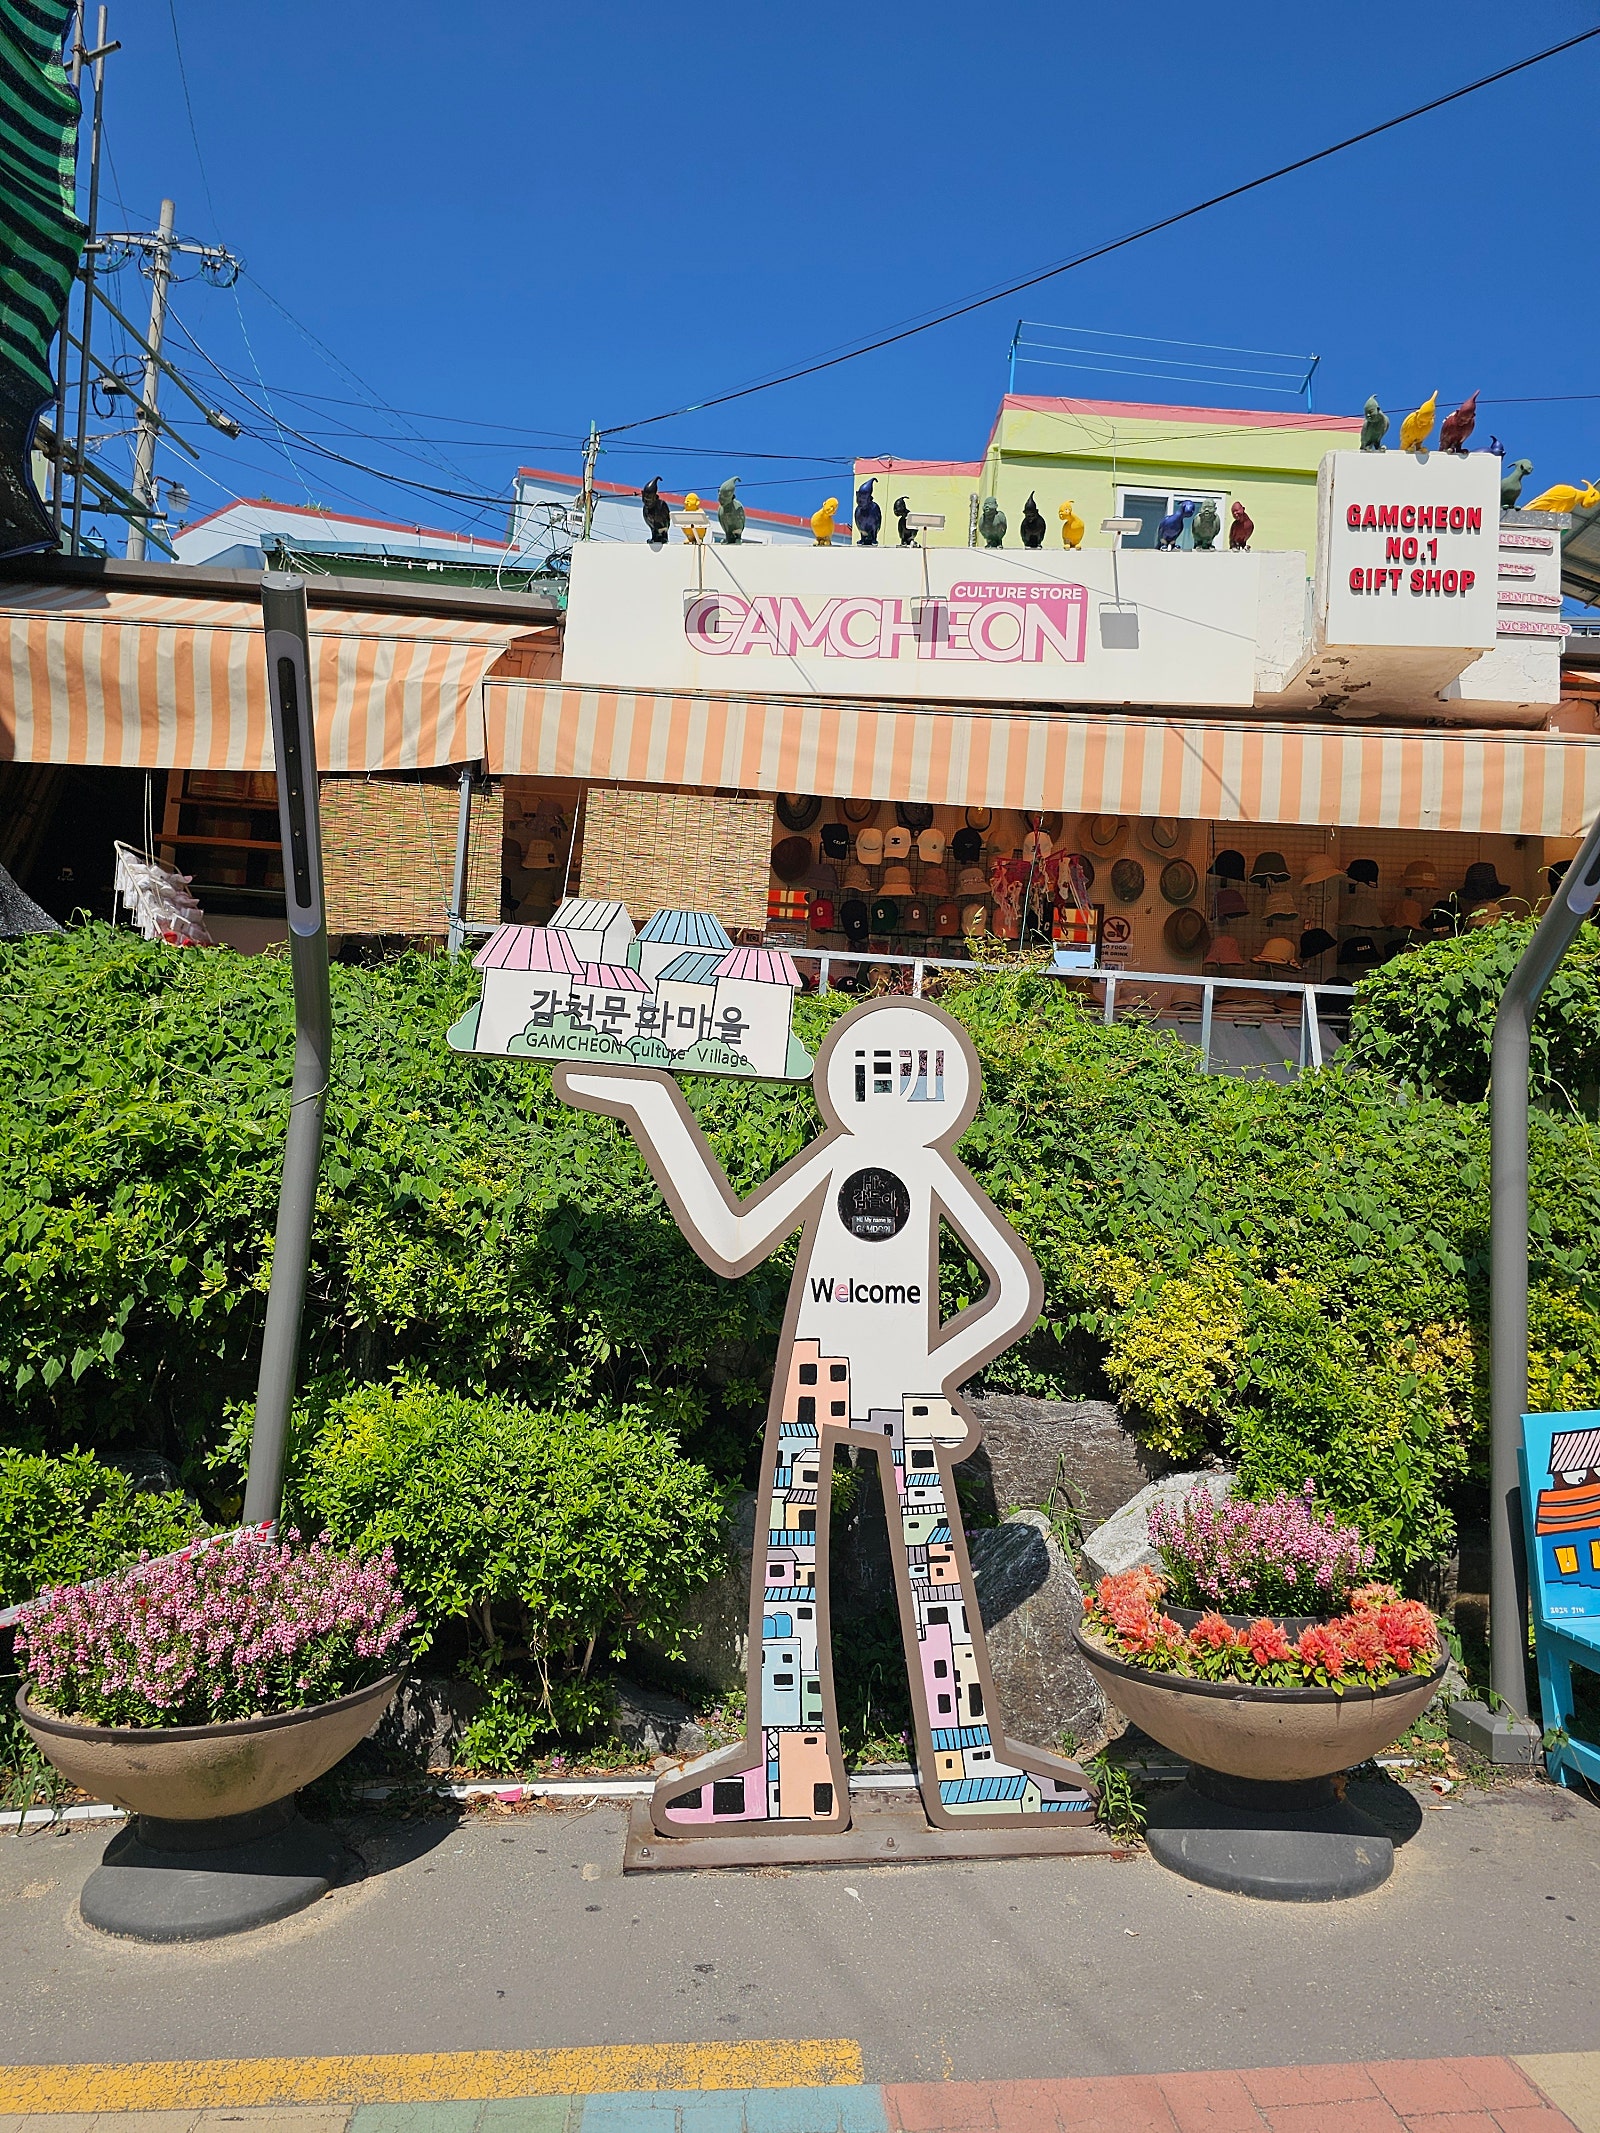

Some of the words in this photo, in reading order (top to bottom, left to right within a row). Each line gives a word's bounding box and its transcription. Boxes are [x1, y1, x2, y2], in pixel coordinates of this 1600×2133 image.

[1346, 504, 1482, 529] GAMCHEON
[1386, 536, 1438, 560] NO.1
[954, 585, 1027, 600] CULTURE
[1030, 587, 1082, 600] STORE
[1350, 567, 1403, 590] GIFT
[1410, 568, 1476, 592] SHOP
[684, 594, 1085, 663] GAMCHEON
[529, 989, 750, 1045] 감천문화마을
[526, 1032, 623, 1055] GAMCHEON
[631, 1042, 686, 1060] Culture
[697, 1047, 748, 1068] Village
[810, 1277, 921, 1304] Welcome
